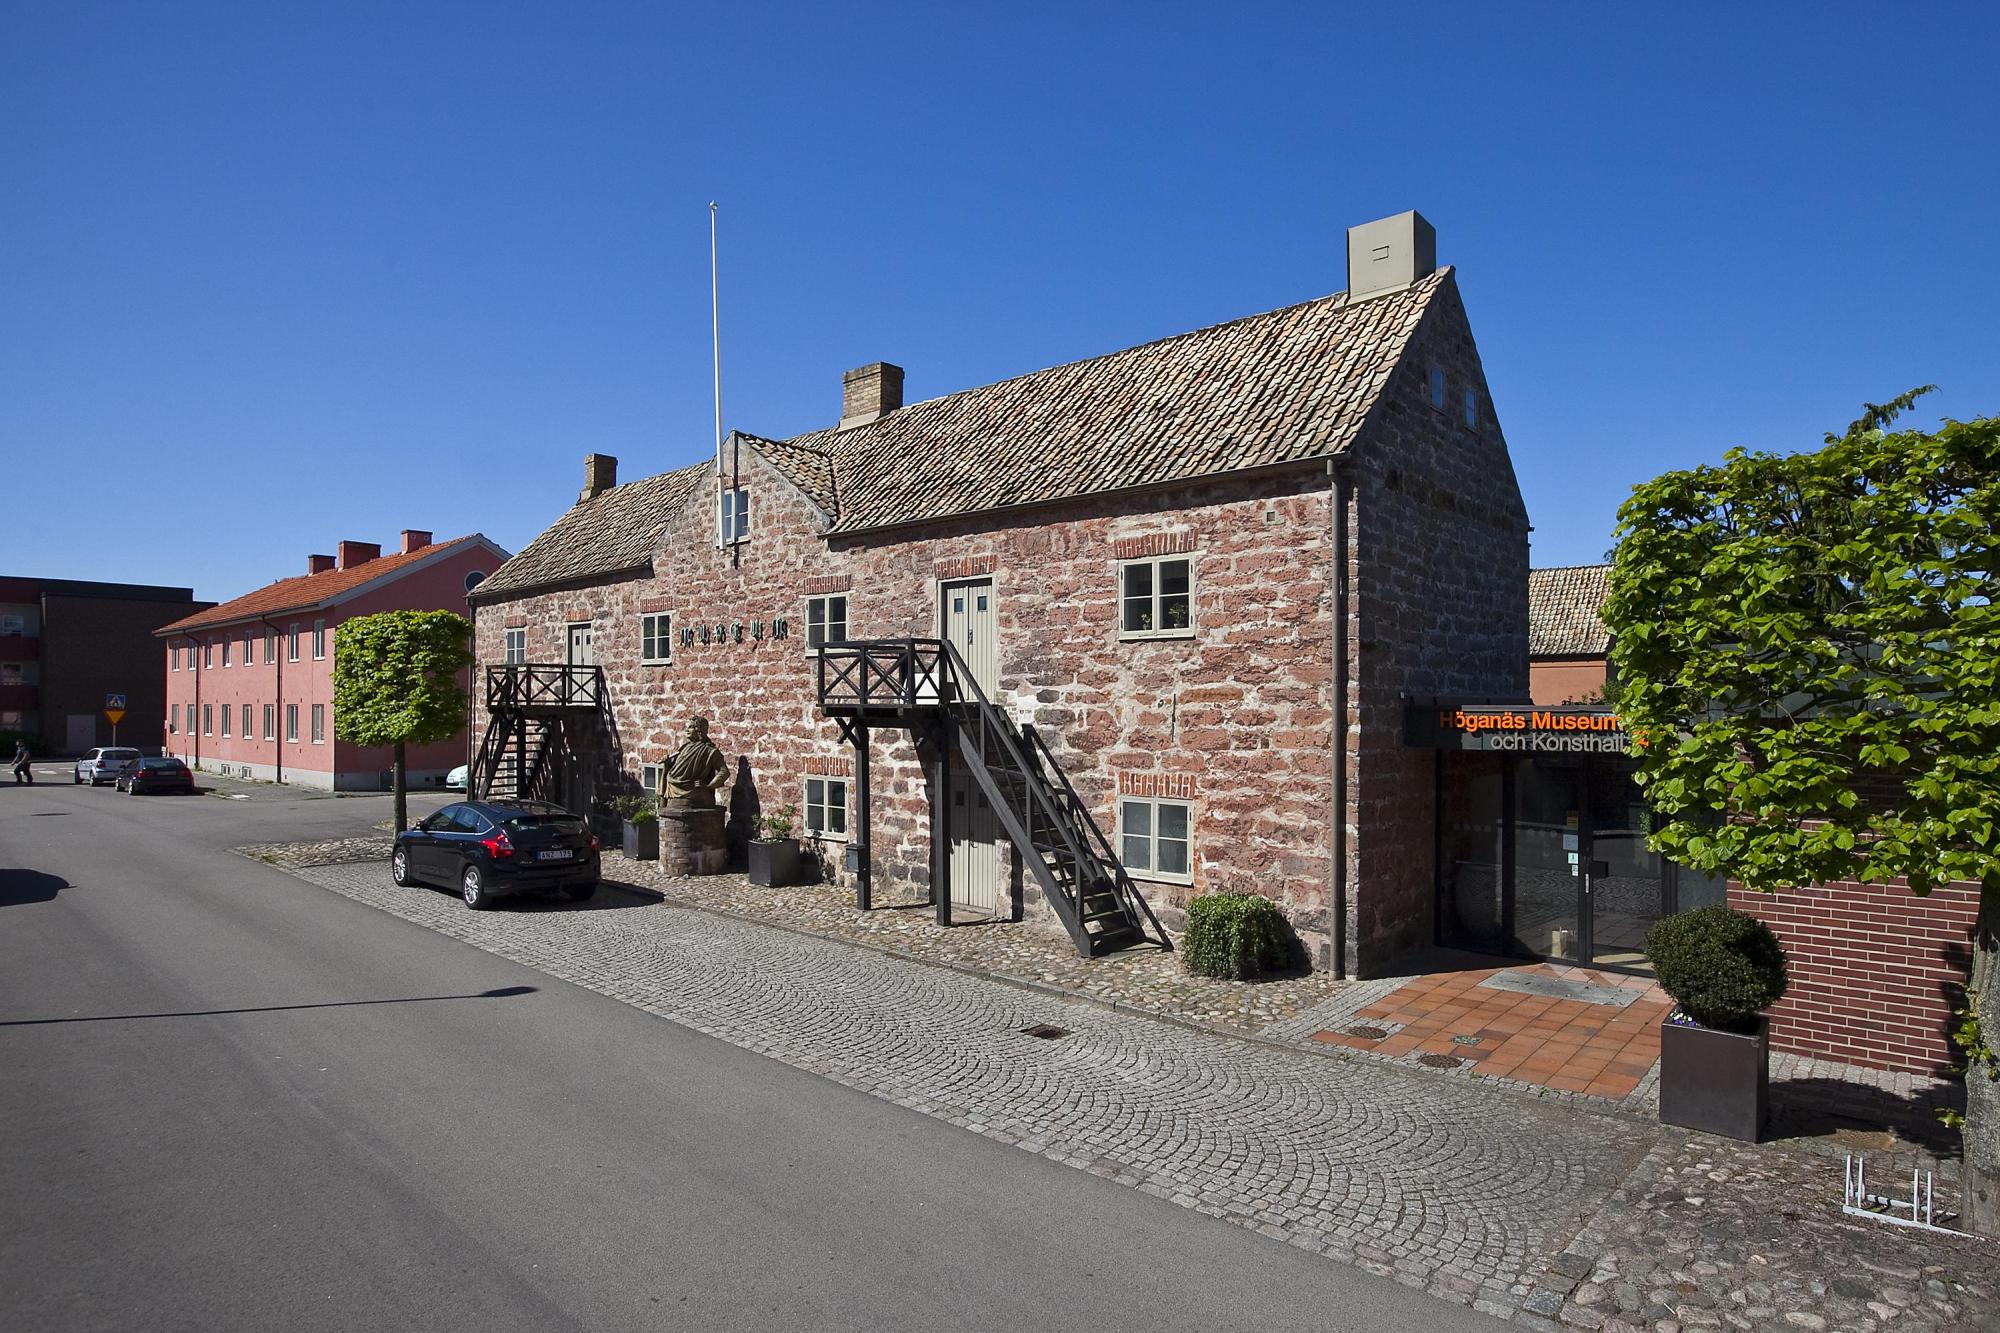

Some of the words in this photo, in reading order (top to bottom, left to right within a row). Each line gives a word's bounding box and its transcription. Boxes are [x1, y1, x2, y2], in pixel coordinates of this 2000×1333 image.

[1440, 711, 1526, 732] Höganäs
[1490, 732, 1526, 750] och
[1532, 732, 1624, 752] Konsthall
